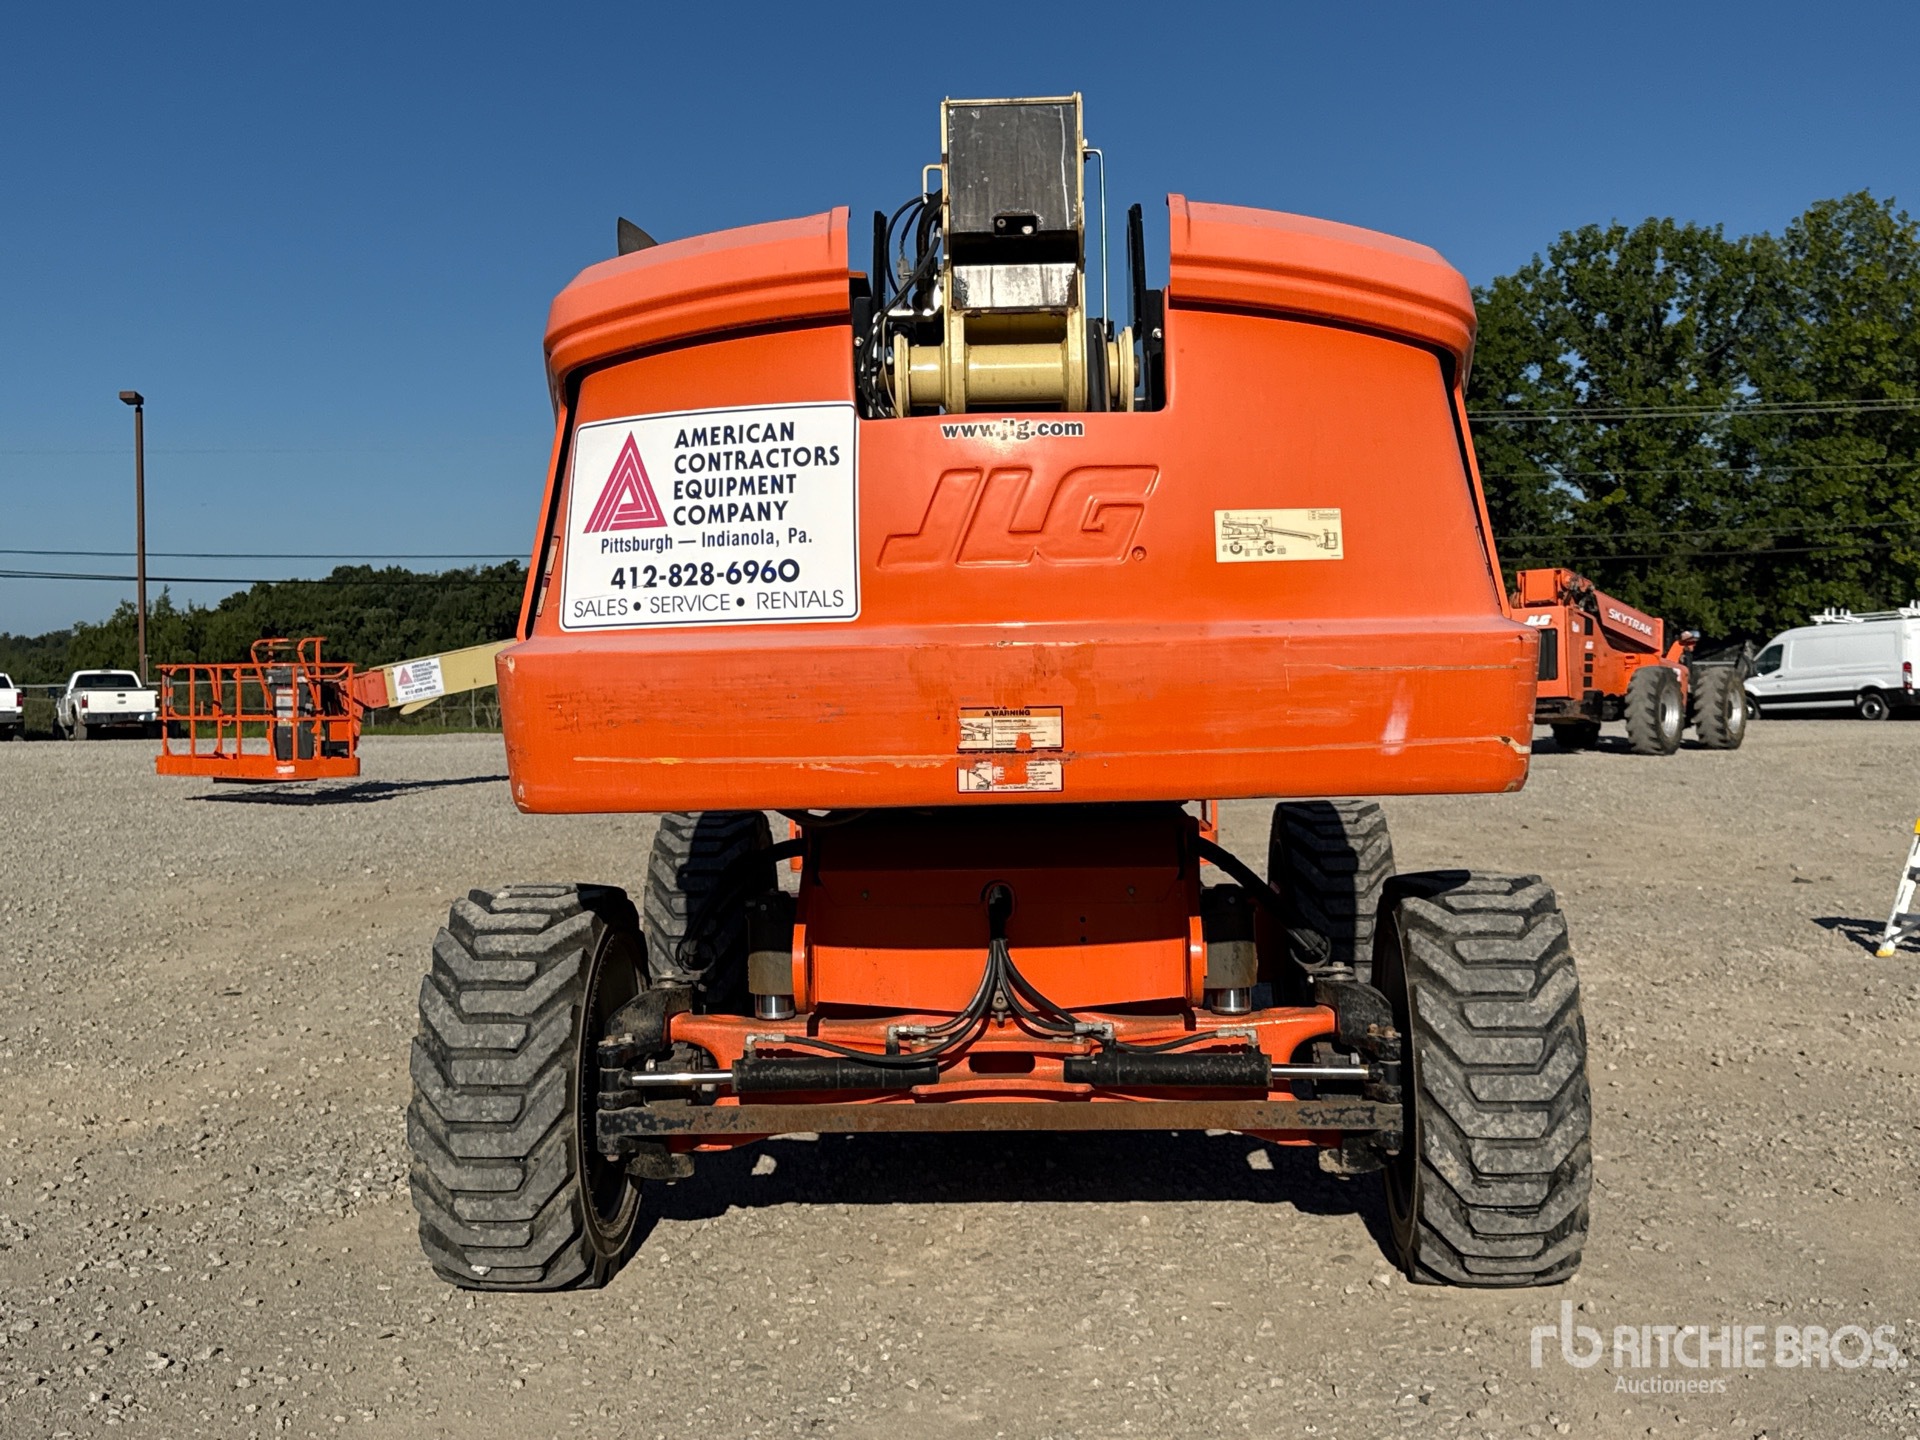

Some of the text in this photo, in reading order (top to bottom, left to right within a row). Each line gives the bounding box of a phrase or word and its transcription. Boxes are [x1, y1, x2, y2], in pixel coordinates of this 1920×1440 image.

[674, 421, 794, 449] AMERICAN
[942, 420, 1083, 440] www.jlg.com
[674, 445, 840, 474] CONTRACTORS
[673, 473, 797, 500] EQUIPMENT
[673, 500, 789, 526] COMPANY
[876, 464, 1160, 570] JLG
[601, 534, 673, 554] Pittsburgh
[702, 529, 779, 548] Indianola,
[788, 527, 813, 544] Pa.
[611, 558, 800, 590] 412-828-6960
[573, 589, 844, 618] SALES SERVICE RENTALS
[1524, 614, 1552, 626] JLG
[1608, 608, 1652, 636] SKYTRAK
[991, 709, 1031, 717] WARNING
